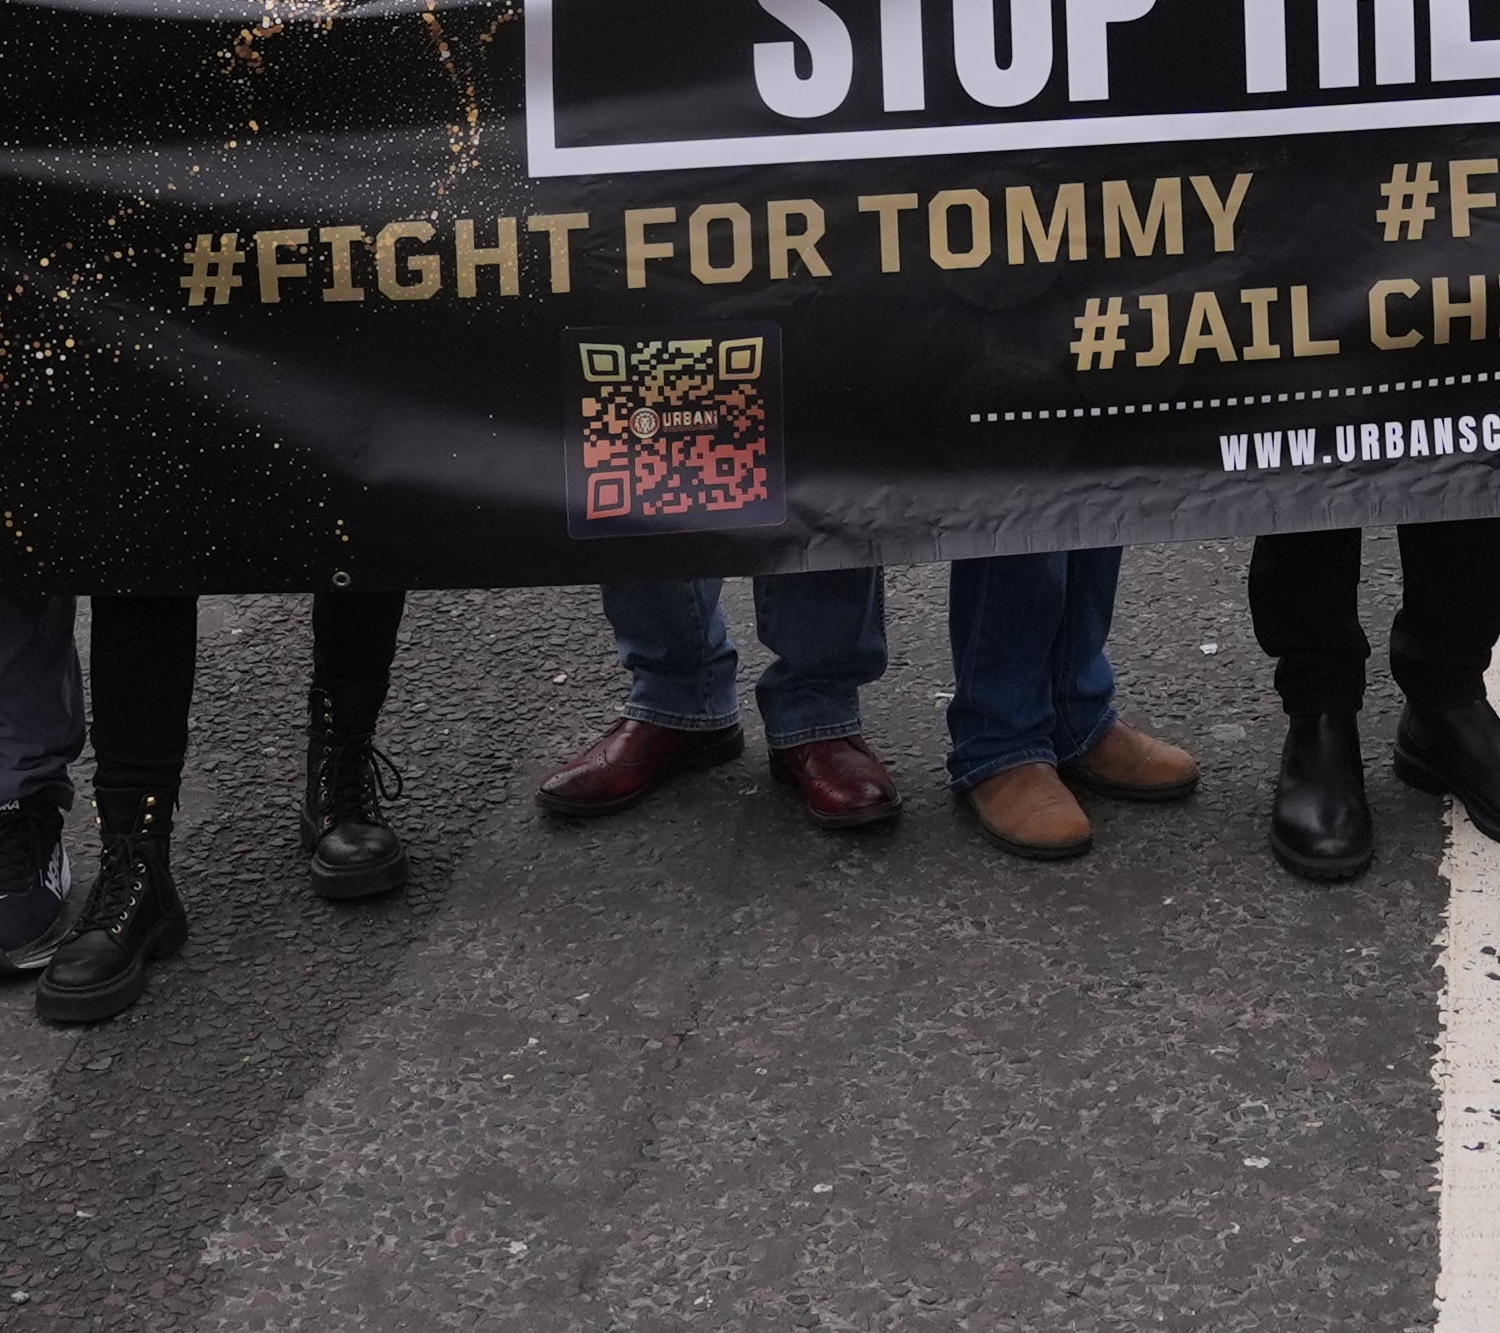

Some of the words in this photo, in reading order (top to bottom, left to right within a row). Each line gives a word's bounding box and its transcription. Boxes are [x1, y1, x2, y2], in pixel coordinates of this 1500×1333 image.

[179, 212, 591, 307] #FIGHT
[599, 196, 832, 290] FOR
[858, 172, 1254, 275] TOMMY
[1070, 280, 1340, 372] #JAIL
